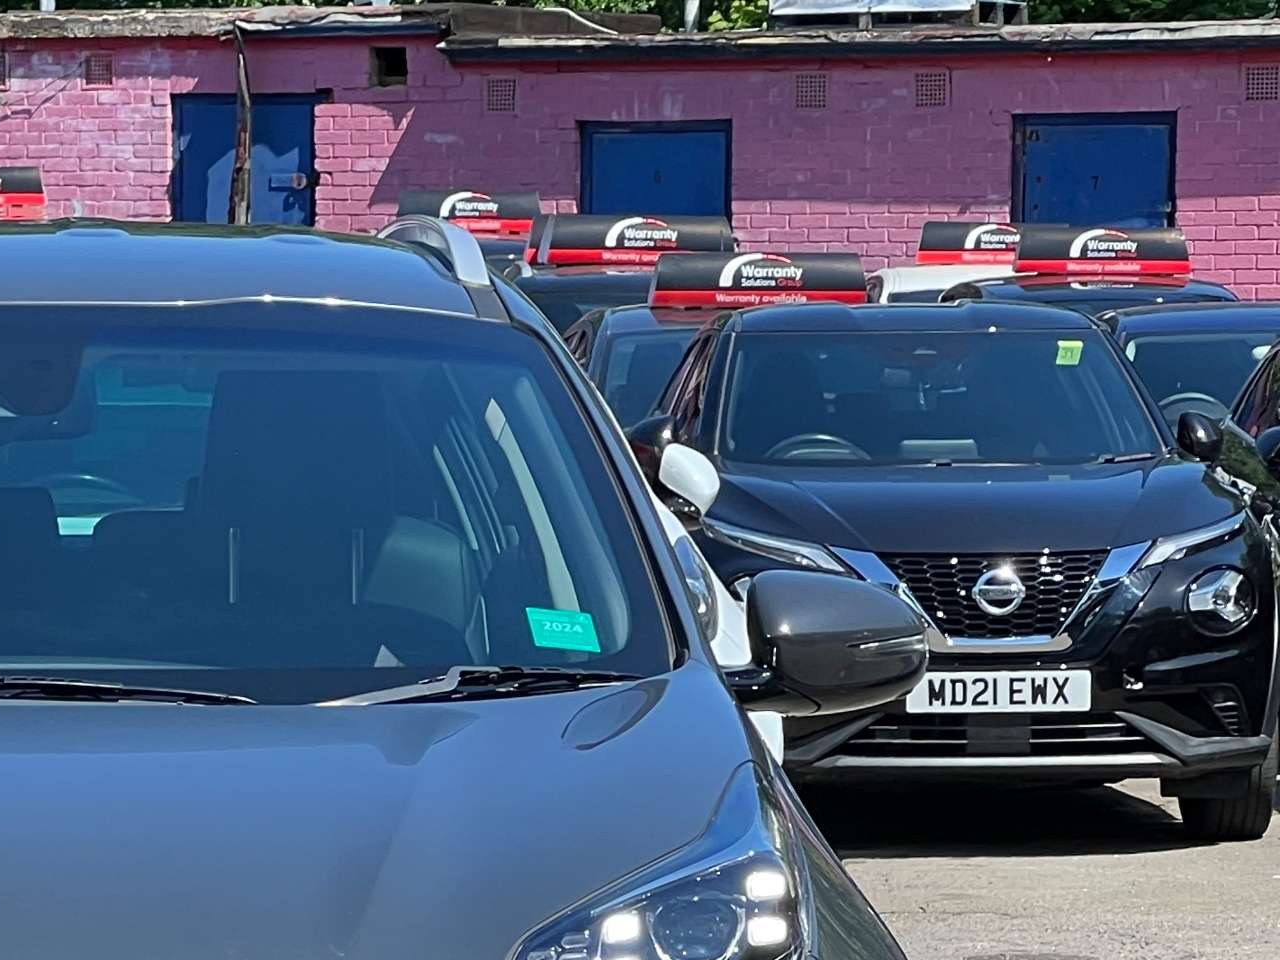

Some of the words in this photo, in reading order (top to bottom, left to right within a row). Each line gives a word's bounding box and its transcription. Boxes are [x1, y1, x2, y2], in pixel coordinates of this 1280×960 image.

[623, 228, 678, 242] Warranty
[980, 233, 1021, 243] Warrant
[1086, 240, 1138, 253] Warranty
[740, 265, 803, 281] Warranty
[740, 279, 776, 287] Solutions
[715, 293, 760, 305] Warranty
[761, 293, 808, 304] available
[542, 621, 583, 634] 2024
[927, 678, 998, 707] MD21
[1008, 676, 1071, 705] EWX
